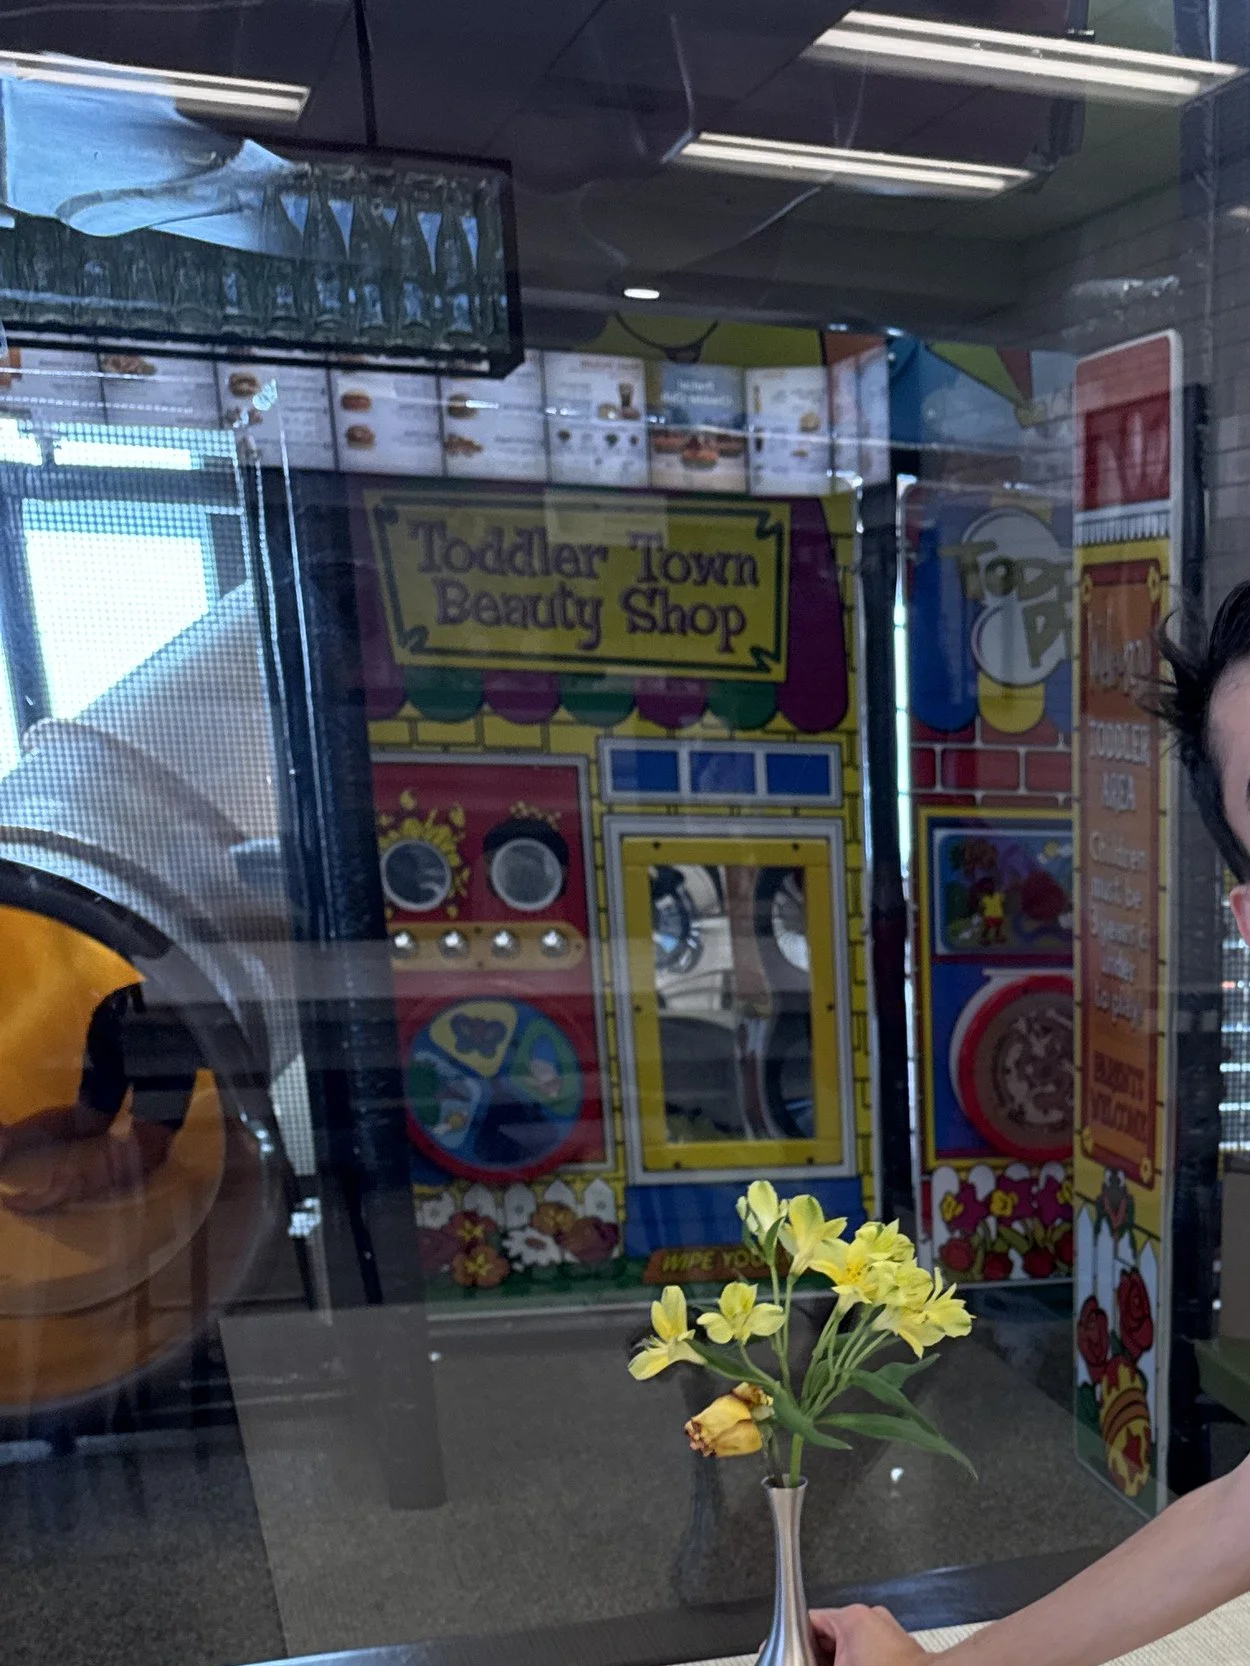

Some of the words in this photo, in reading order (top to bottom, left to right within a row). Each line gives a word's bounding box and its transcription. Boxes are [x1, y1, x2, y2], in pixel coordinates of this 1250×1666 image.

[407, 518, 609, 579] Toddler
[627, 530, 760, 588] Town
[432, 575, 605, 650] Beauty
[620, 586, 747, 654] Shop
[661, 1250, 714, 1272] WIPE
[722, 1250, 764, 1269] YOU
